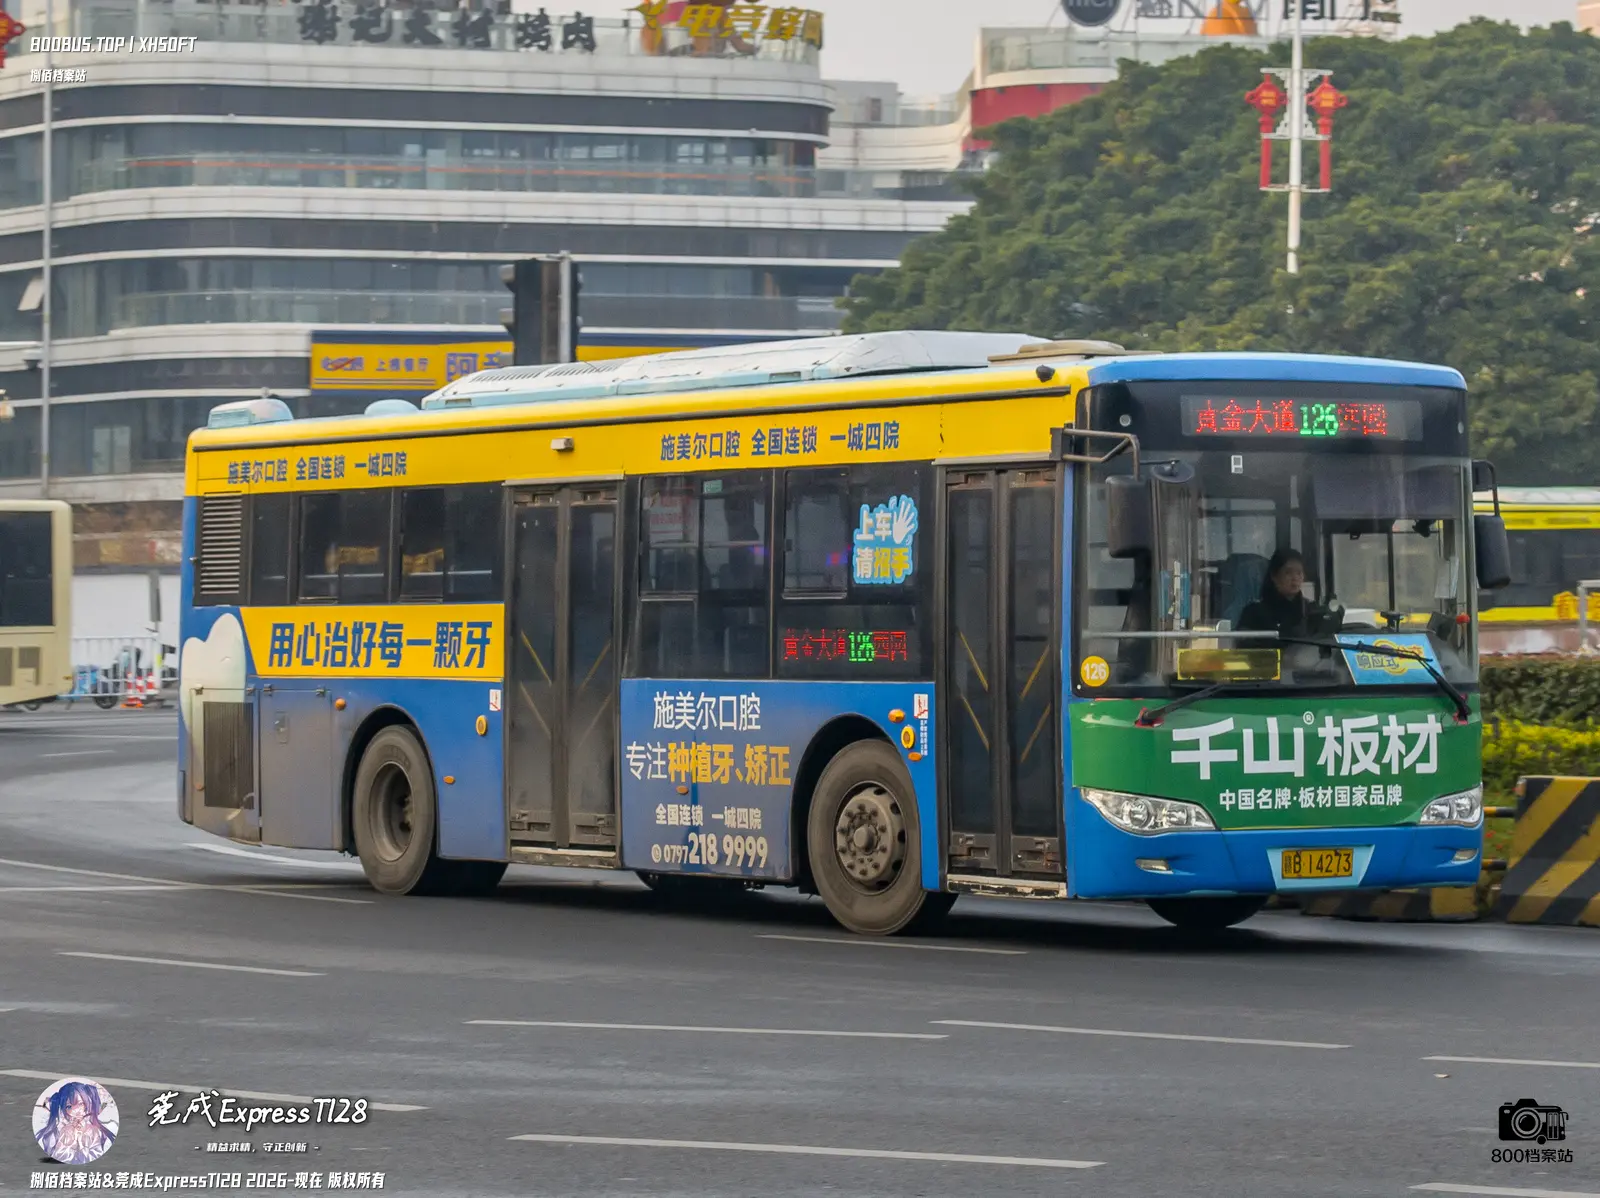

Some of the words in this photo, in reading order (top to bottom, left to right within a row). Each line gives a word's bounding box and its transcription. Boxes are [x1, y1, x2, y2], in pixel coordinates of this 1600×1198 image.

[660, 430, 740, 461] 施美尔口腔
[751, 425, 818, 456] 全国连锁
[829, 421, 900, 451] 一城四院
[228, 459, 288, 484] 施美尔口腔
[296, 456, 345, 481] 全国连锁
[354, 452, 407, 477] 一城四院
[856, 510, 892, 542] 上车
[268, 621, 493, 668] 用心治好每一颗牙
[1084, 662, 1107, 680] 126
[653, 691, 761, 731] 施美尔口腔
[625, 741, 792, 786] 专注种植牙、矫正
[655, 803, 704, 826] 全国连锁
[711, 806, 762, 829] 一城四院
[722, 834, 768, 873] 9999
